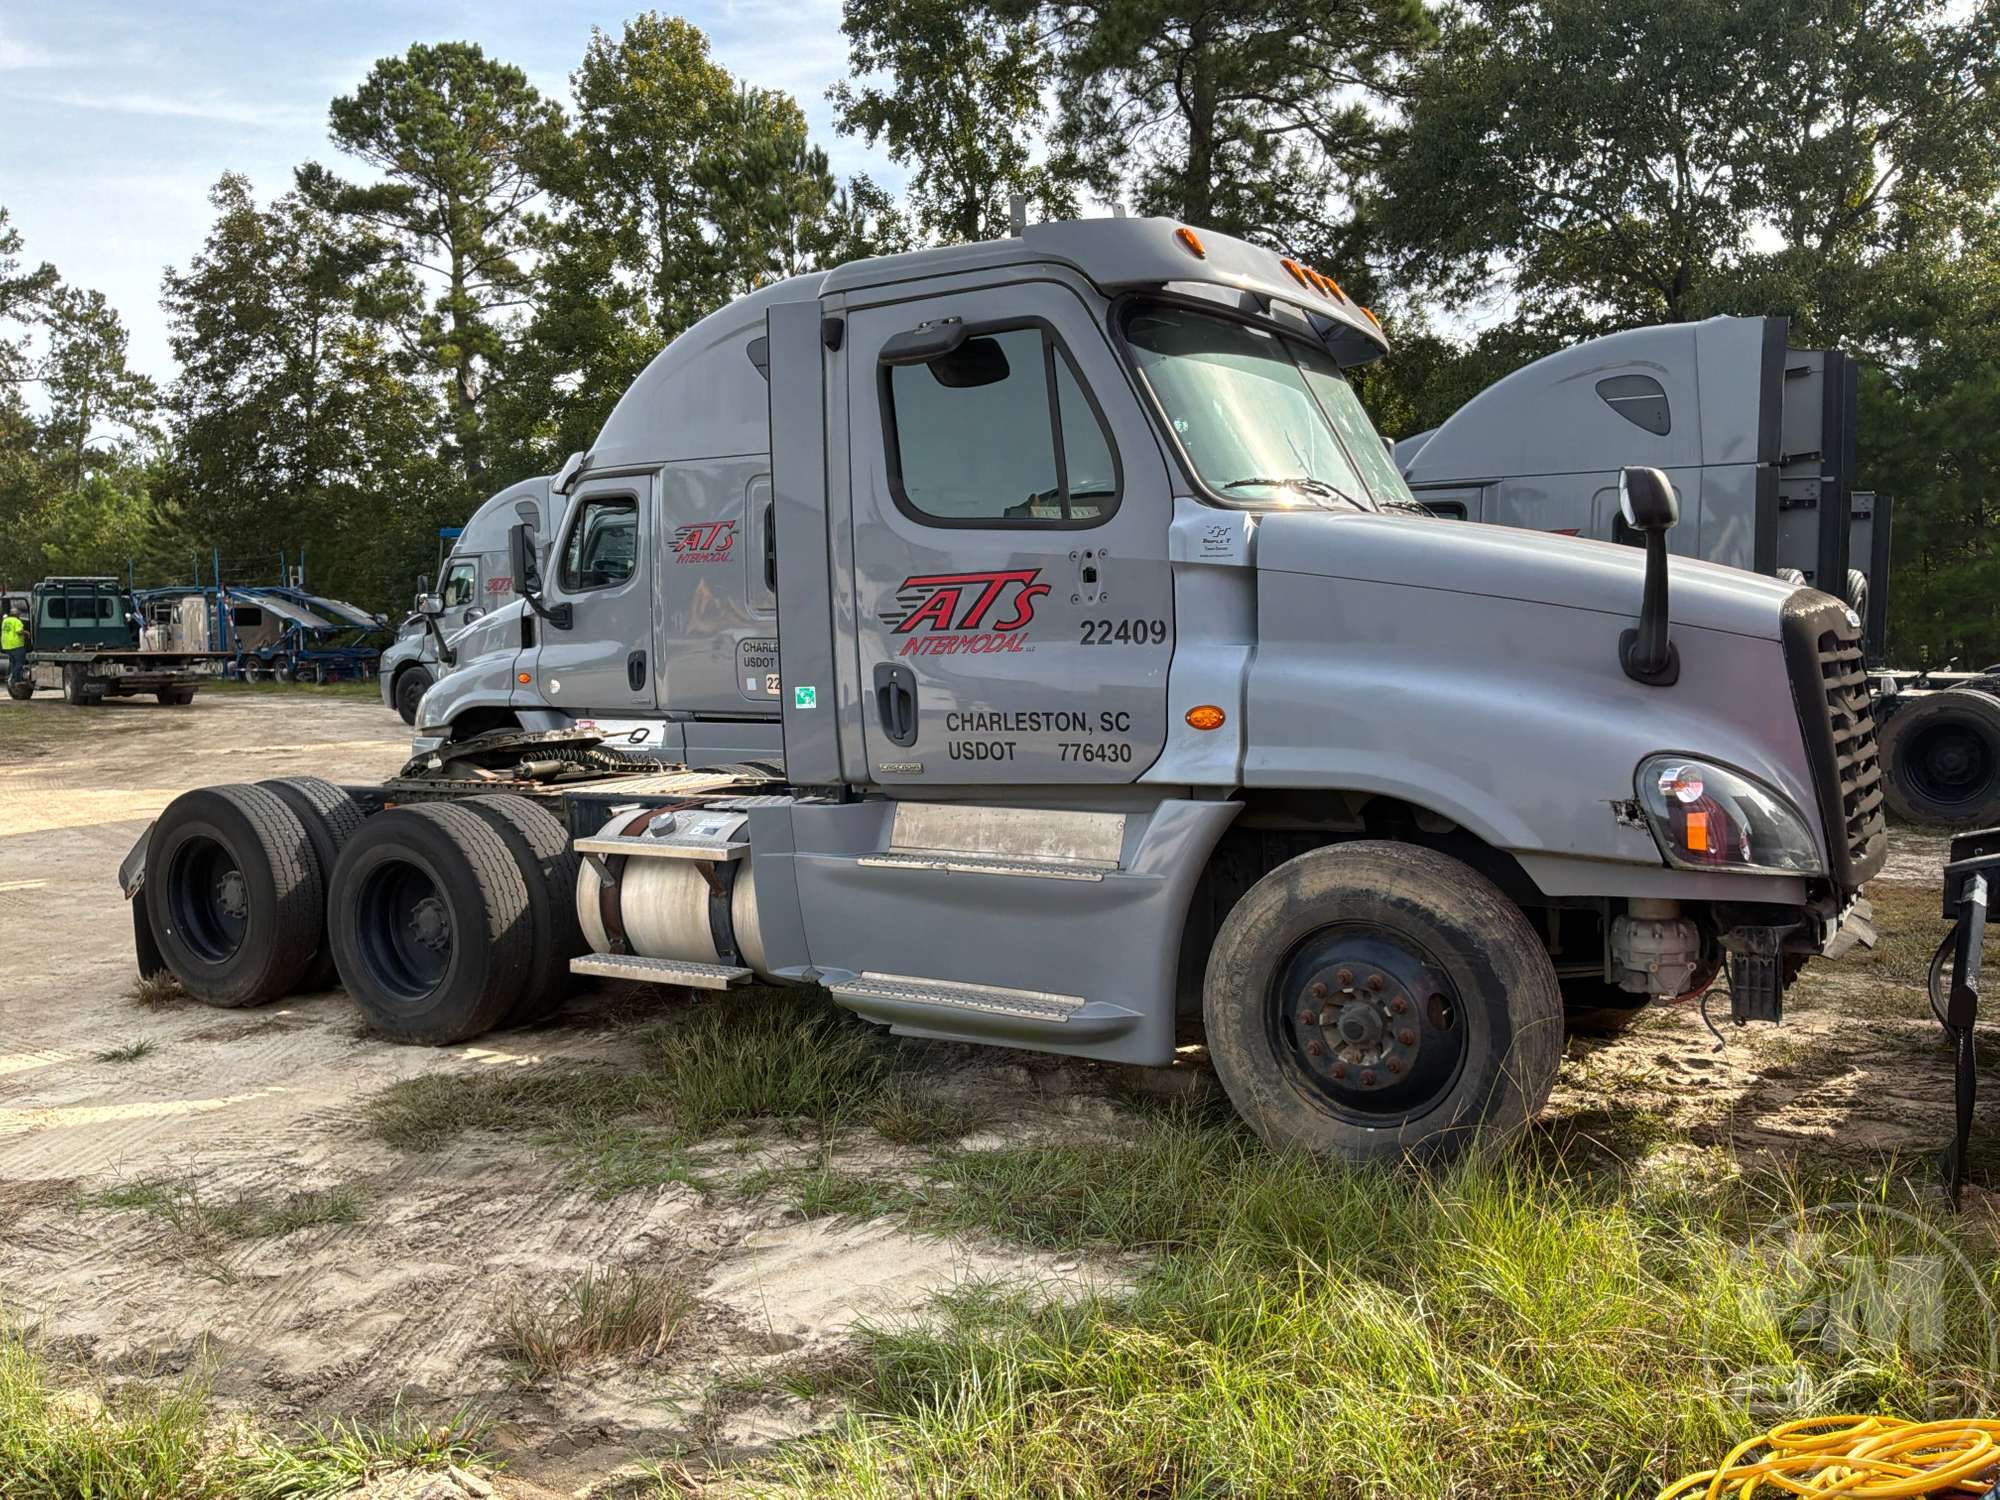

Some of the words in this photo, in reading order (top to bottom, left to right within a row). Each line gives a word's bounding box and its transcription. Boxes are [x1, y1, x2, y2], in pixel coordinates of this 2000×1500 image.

[673, 520, 739, 552] ATS
[890, 567, 1052, 634] ATS
[899, 632, 1029, 657] INTERMODAL
[1080, 619, 1167, 645] 22409
[744, 657, 775, 668] USDOT
[946, 711, 1093, 735] CHARLESTON,
[1100, 711, 1131, 732] SC
[949, 742, 1016, 761] USDOT
[1058, 743, 1132, 763] 776430
